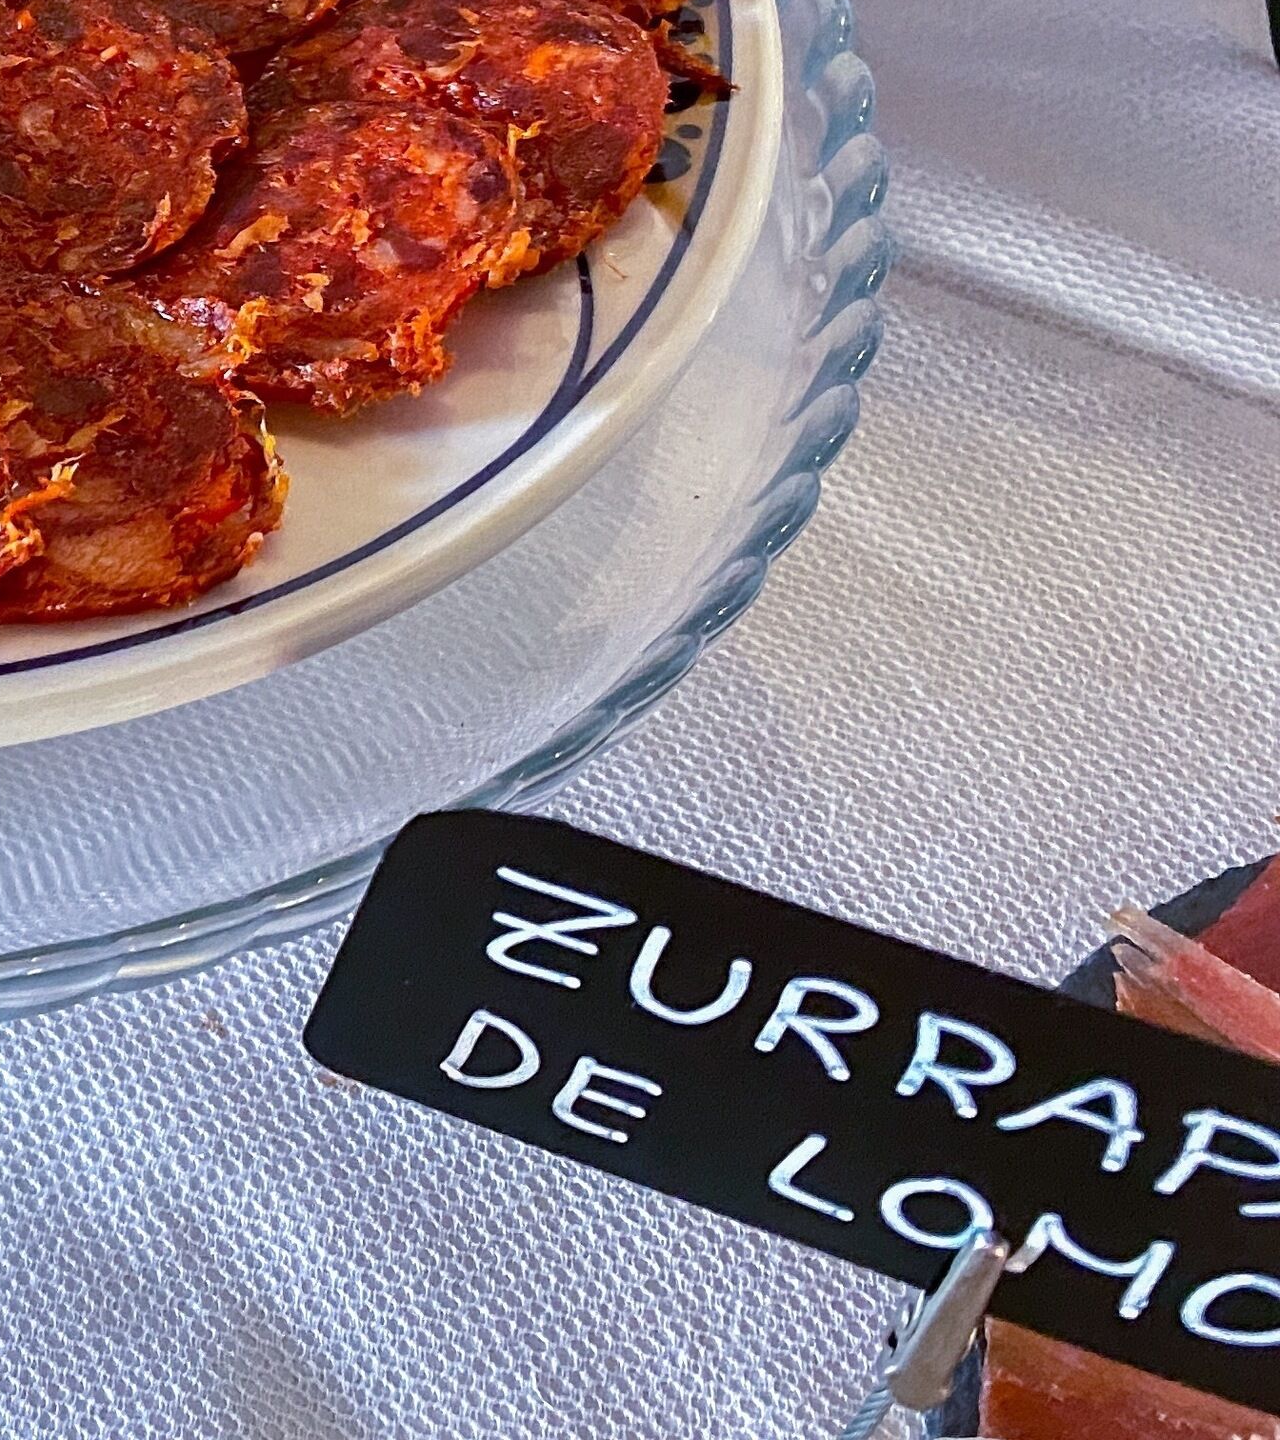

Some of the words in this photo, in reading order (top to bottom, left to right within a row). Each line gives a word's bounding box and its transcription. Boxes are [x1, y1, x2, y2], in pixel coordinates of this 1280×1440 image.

[440, 1009, 663, 1142] DE
[769, 1134, 1280, 1346] LOMO
[486, 866, 1280, 1217] ZURRAP
